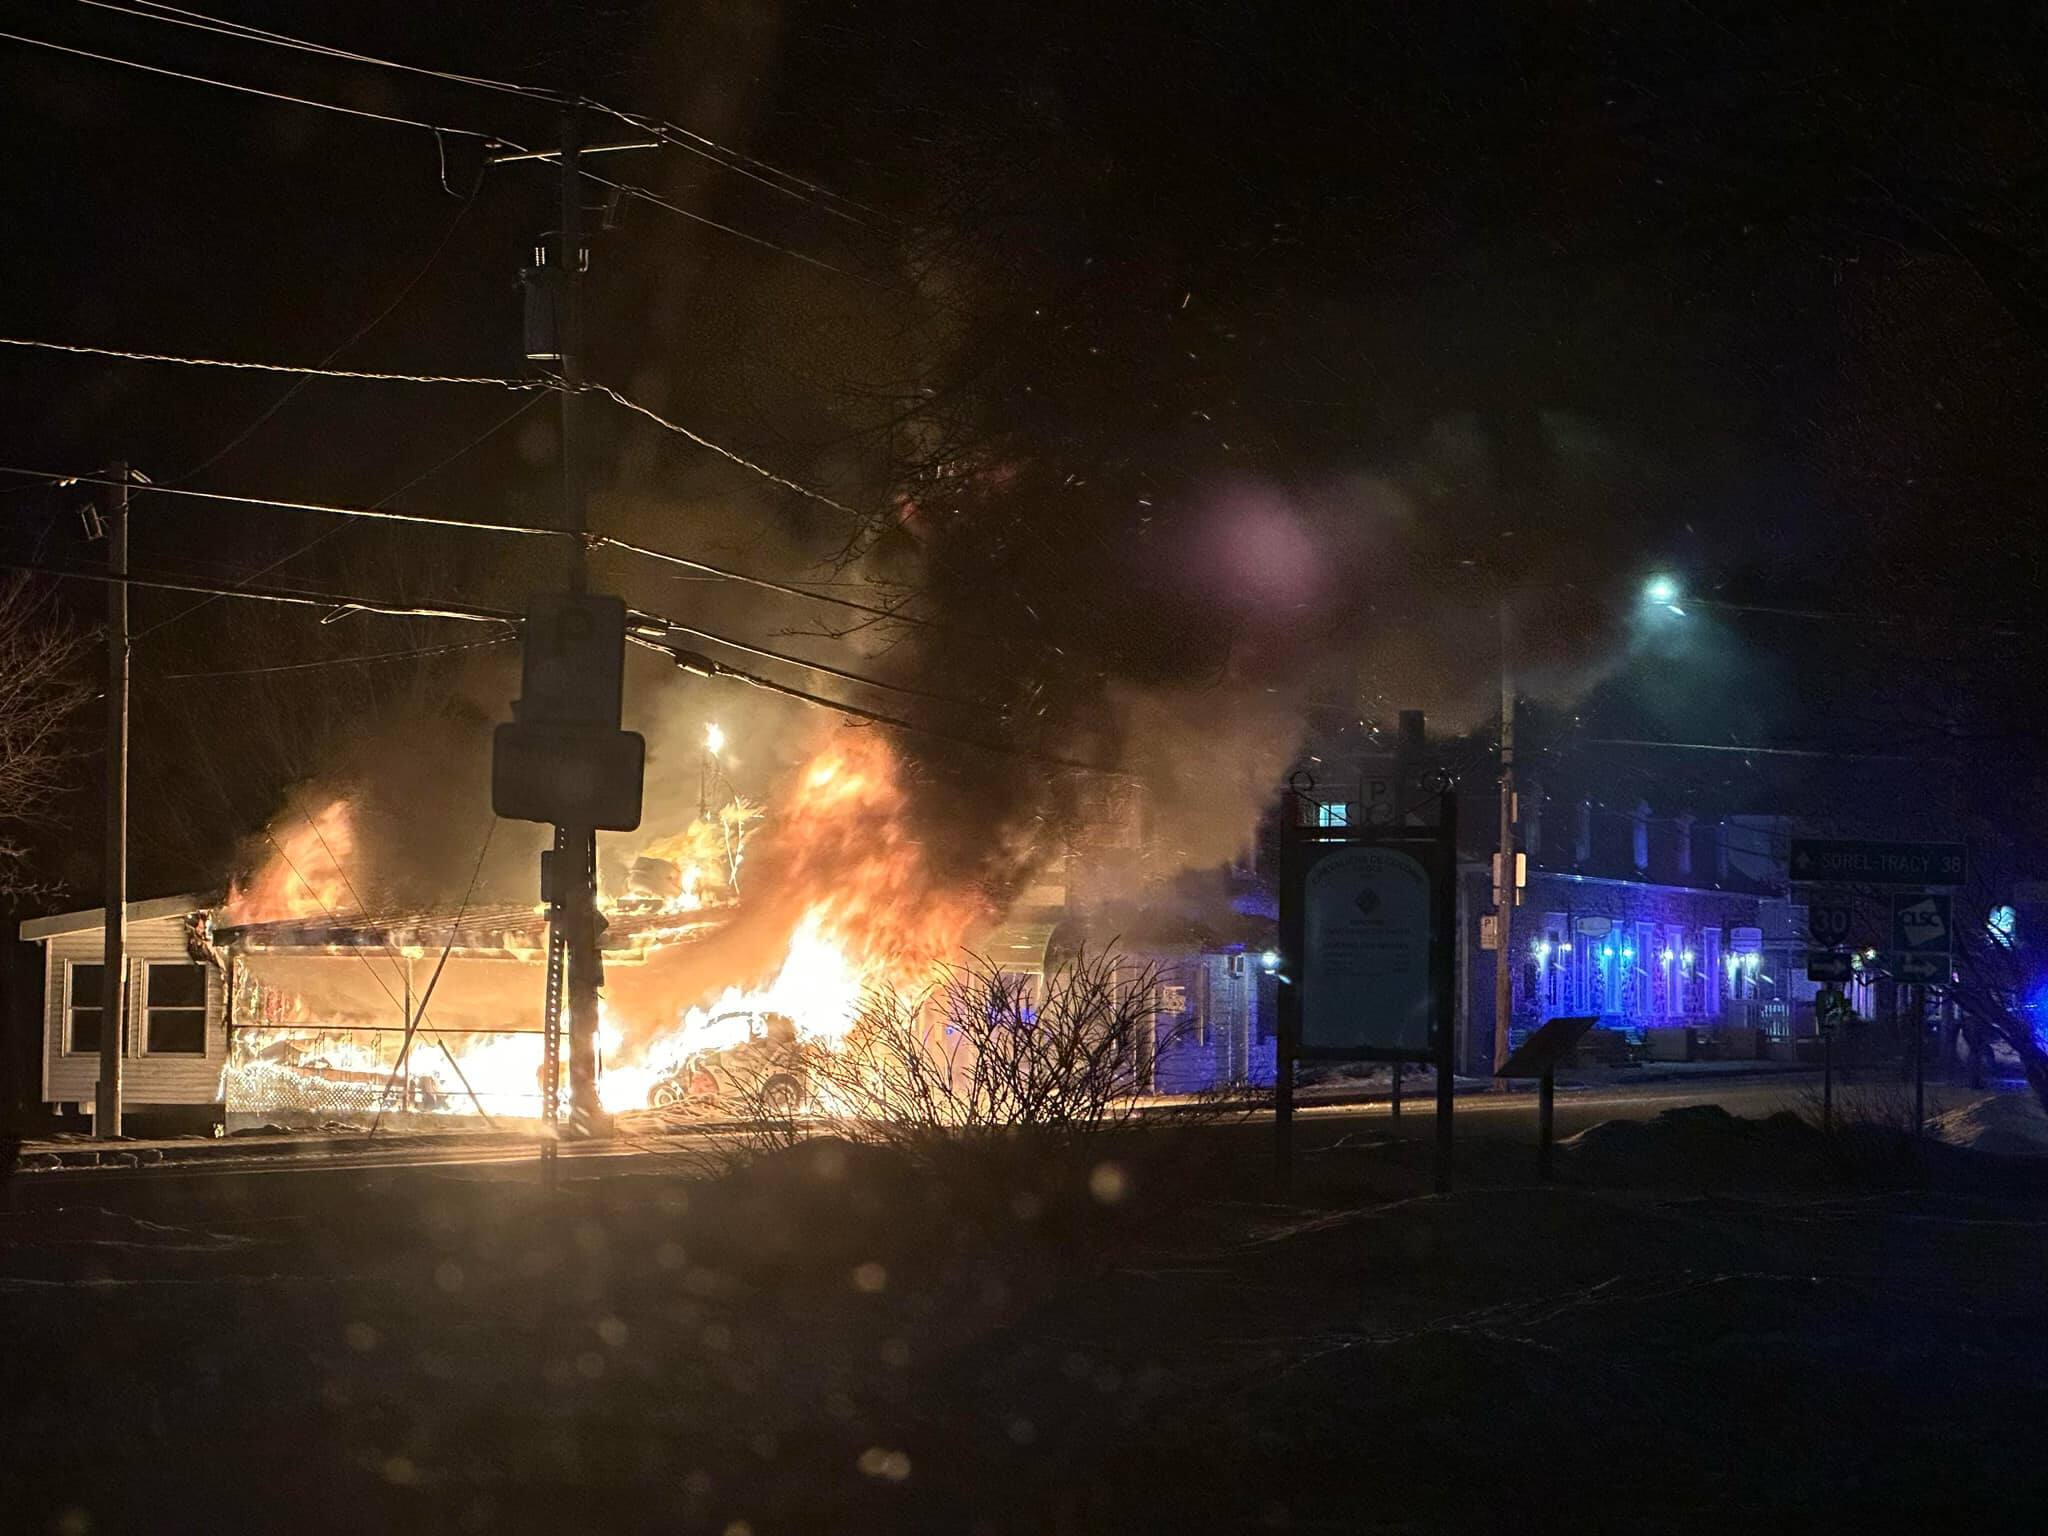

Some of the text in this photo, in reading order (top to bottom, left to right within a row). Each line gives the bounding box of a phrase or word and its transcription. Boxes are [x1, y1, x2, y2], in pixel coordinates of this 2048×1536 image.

[1822, 854, 1961, 873] SOREL-TRACY 38
[1815, 909, 1847, 933] 30
[1902, 911, 1942, 927] CLSC
